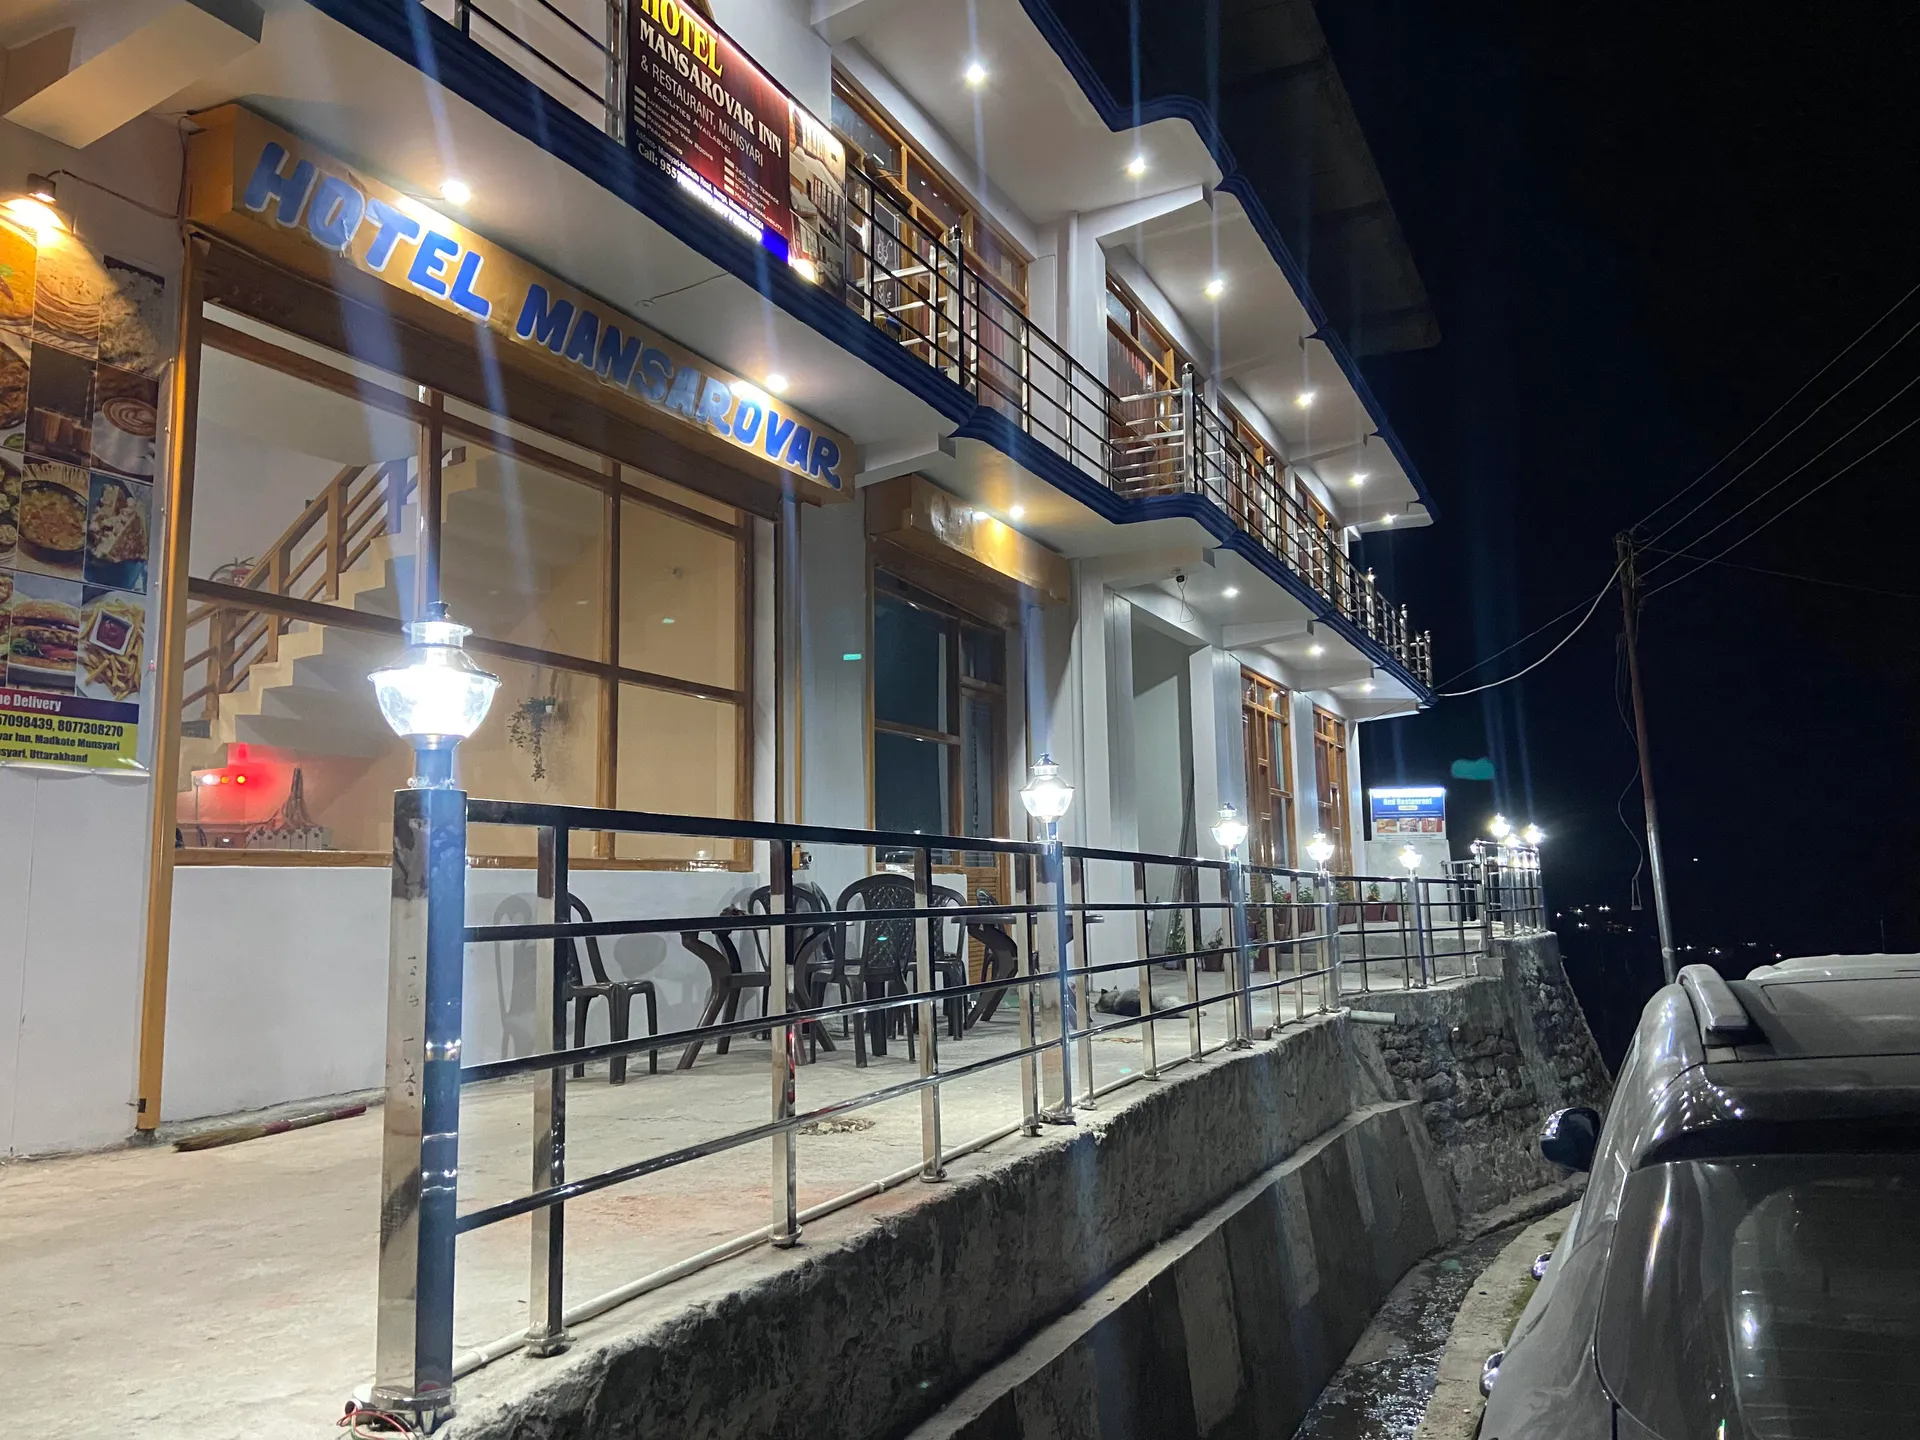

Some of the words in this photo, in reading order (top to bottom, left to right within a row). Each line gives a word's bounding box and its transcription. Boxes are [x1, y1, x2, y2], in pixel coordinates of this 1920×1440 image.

[640, 18, 755, 135] MANSAROVAR
[758, 121, 782, 158] INN
[640, 55, 649, 73] &
[652, 63, 717, 130] RESTAURANT,
[719, 118, 763, 167] MUNSYARI
[647, 96, 669, 116] LUXURY
[671, 115, 690, 134] ROOMS
[647, 115, 671, 136] PARKING
[653, 86, 691, 121] FACILITIES
[693, 119, 731, 153] AVAILABLE:
[647, 105, 679, 134] PANORAMIC
[680, 131, 693, 144] VIEW
[694, 142, 713, 161] ROOMS
[647, 124, 683, 155] PARAGLIDING
[638, 142, 658, 166] Call:
[245, 141, 492, 322] HOTEL
[516, 283, 842, 490] MANSAROVAR
[13, 694, 61, 712] Delivery
[0, 713, 55, 732] 7098439,
[58, 720, 124, 737] 8077308270
[30, 749, 88, 763] Uttarakhand
[35, 734, 76, 747] Madkote
[77, 738, 120, 751] Munsyari
